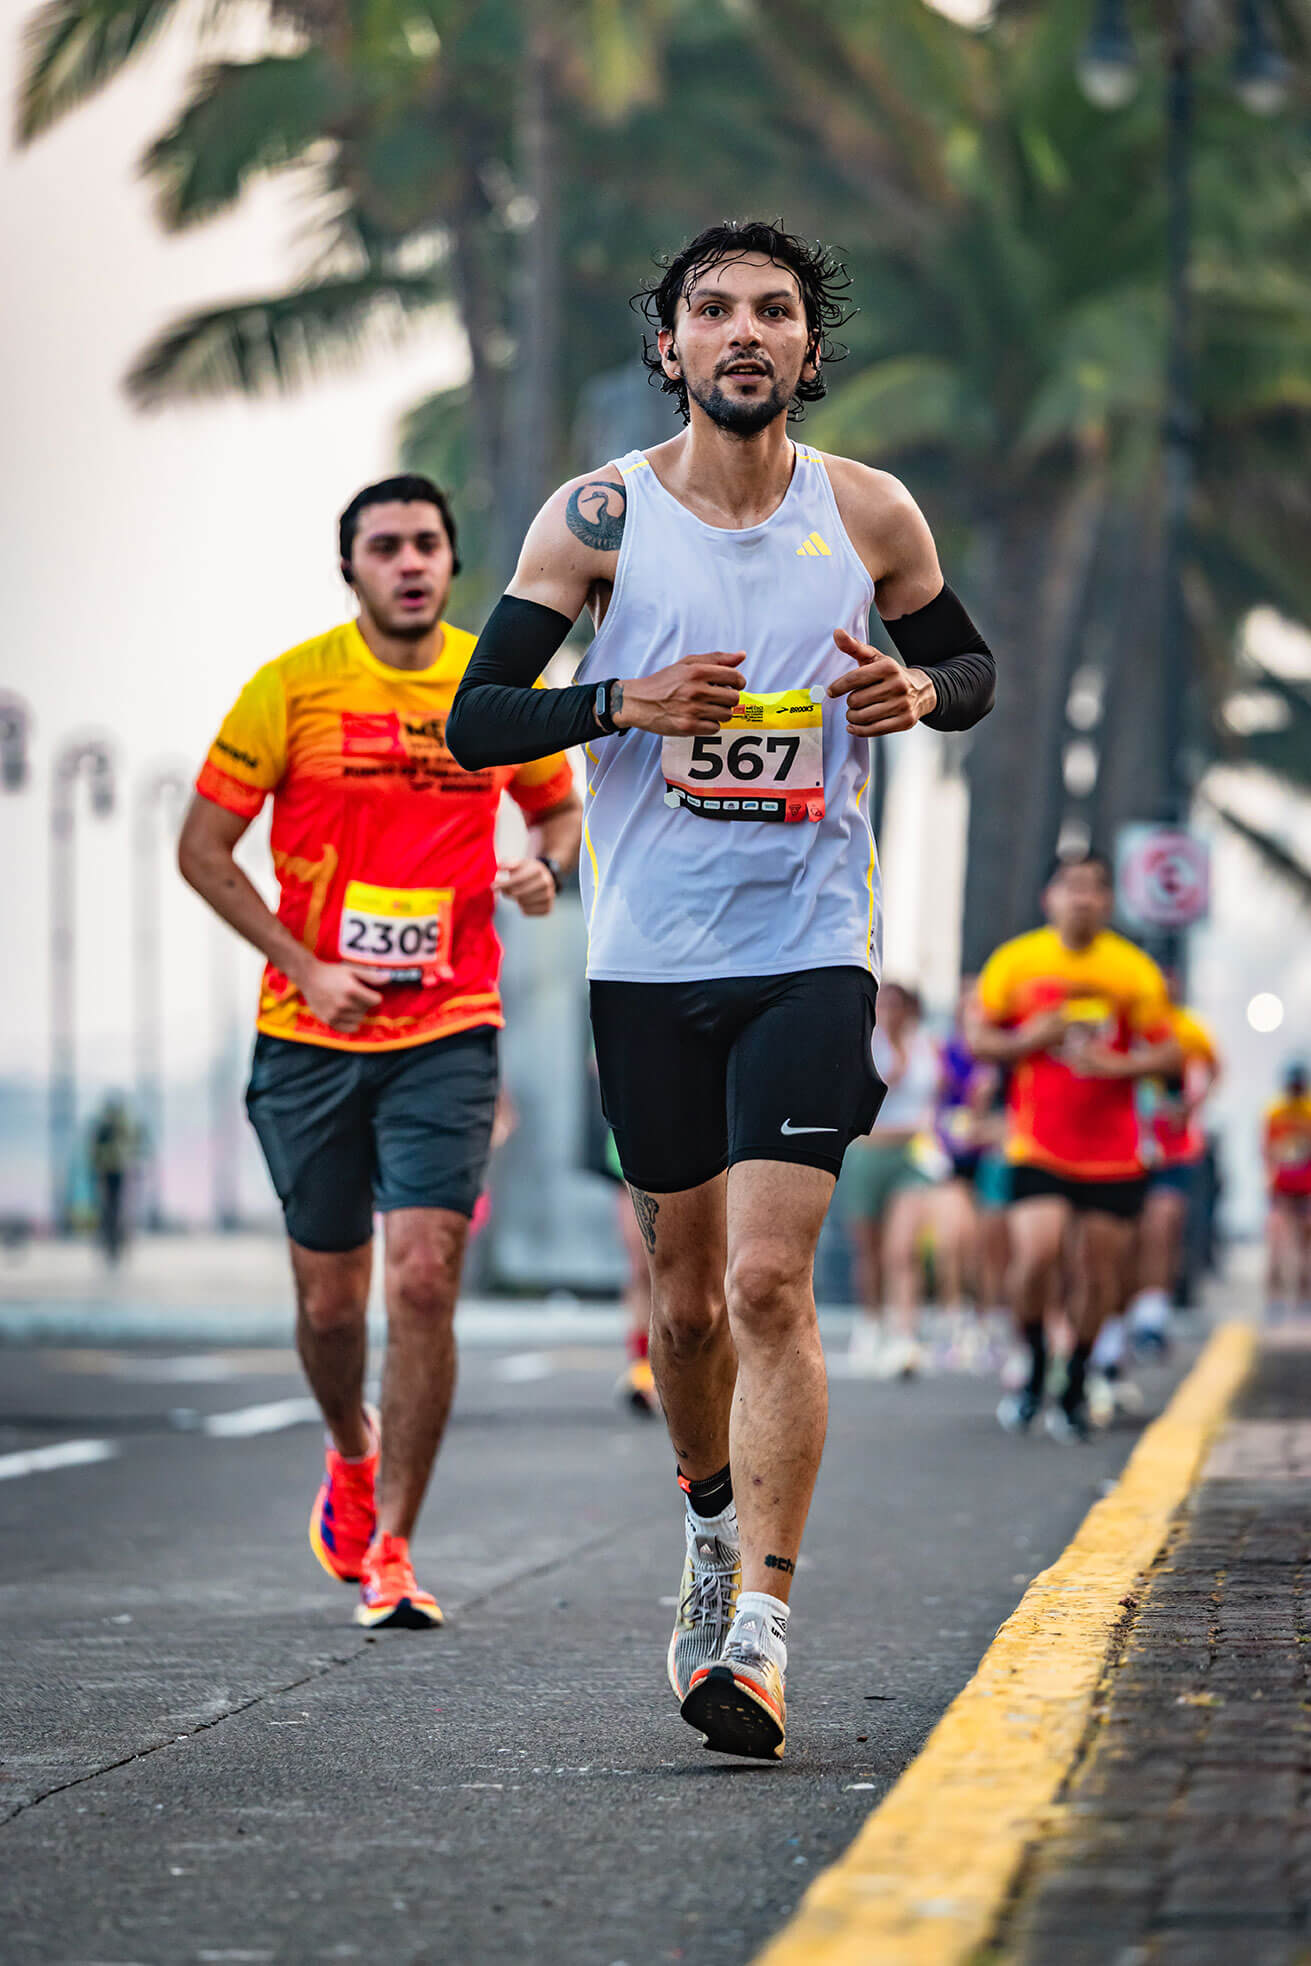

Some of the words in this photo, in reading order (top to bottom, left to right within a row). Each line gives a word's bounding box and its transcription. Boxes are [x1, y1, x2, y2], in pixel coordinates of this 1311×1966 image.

[790, 705, 814, 713] BROOKS
[688, 736, 800, 781] 567
[347, 918, 437, 956] 2309
